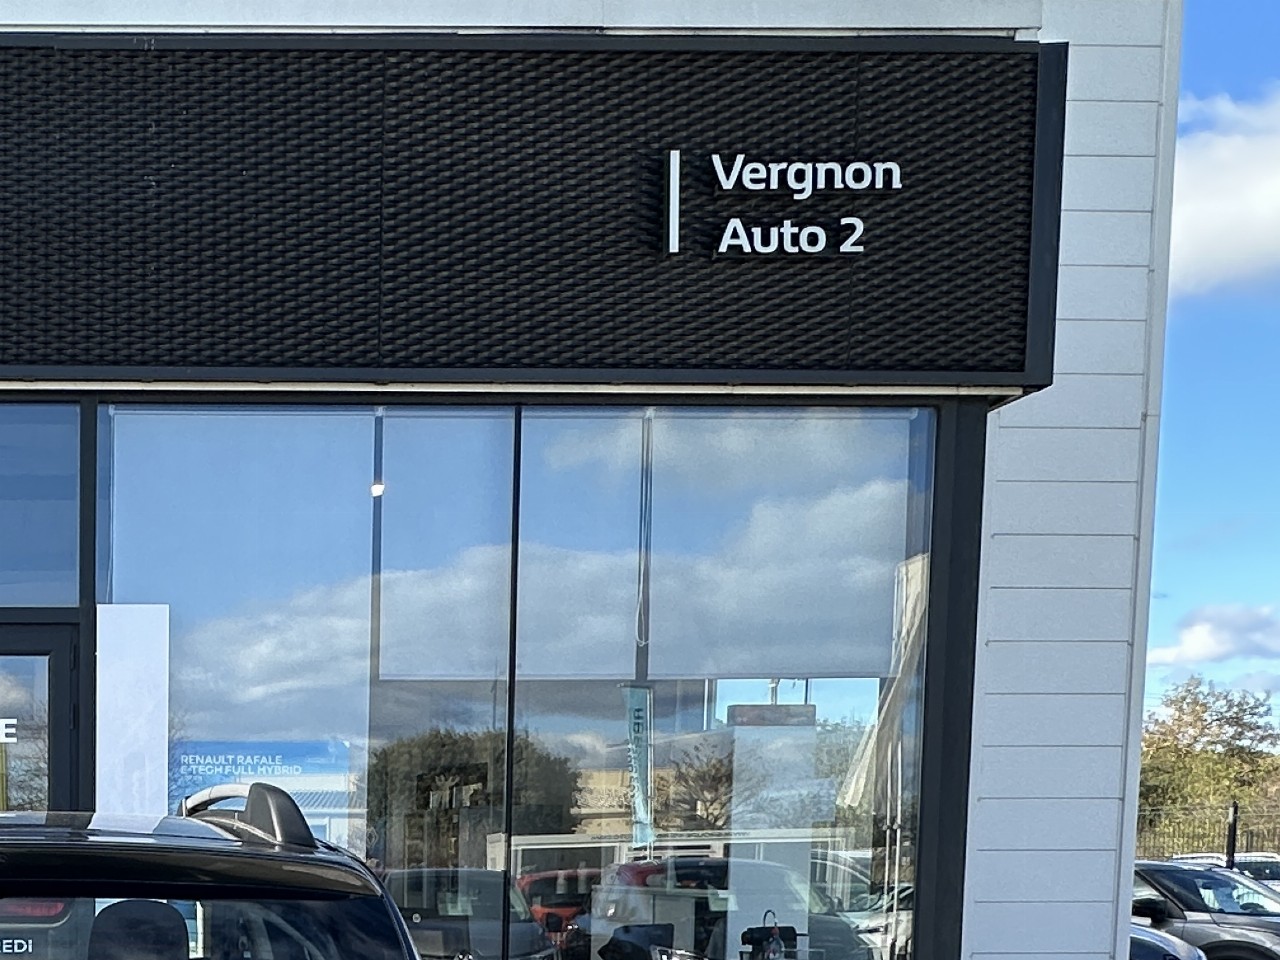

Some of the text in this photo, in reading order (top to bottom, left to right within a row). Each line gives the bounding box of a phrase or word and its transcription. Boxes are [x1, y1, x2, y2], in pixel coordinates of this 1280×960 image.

[711, 153, 903, 200] Vergnon
[718, 217, 864, 253] Auto 2
[181, 755, 282, 765] RENAULT RAFALE
[225, 765, 255, 775] FULL
[257, 765, 302, 775] HYBRID
